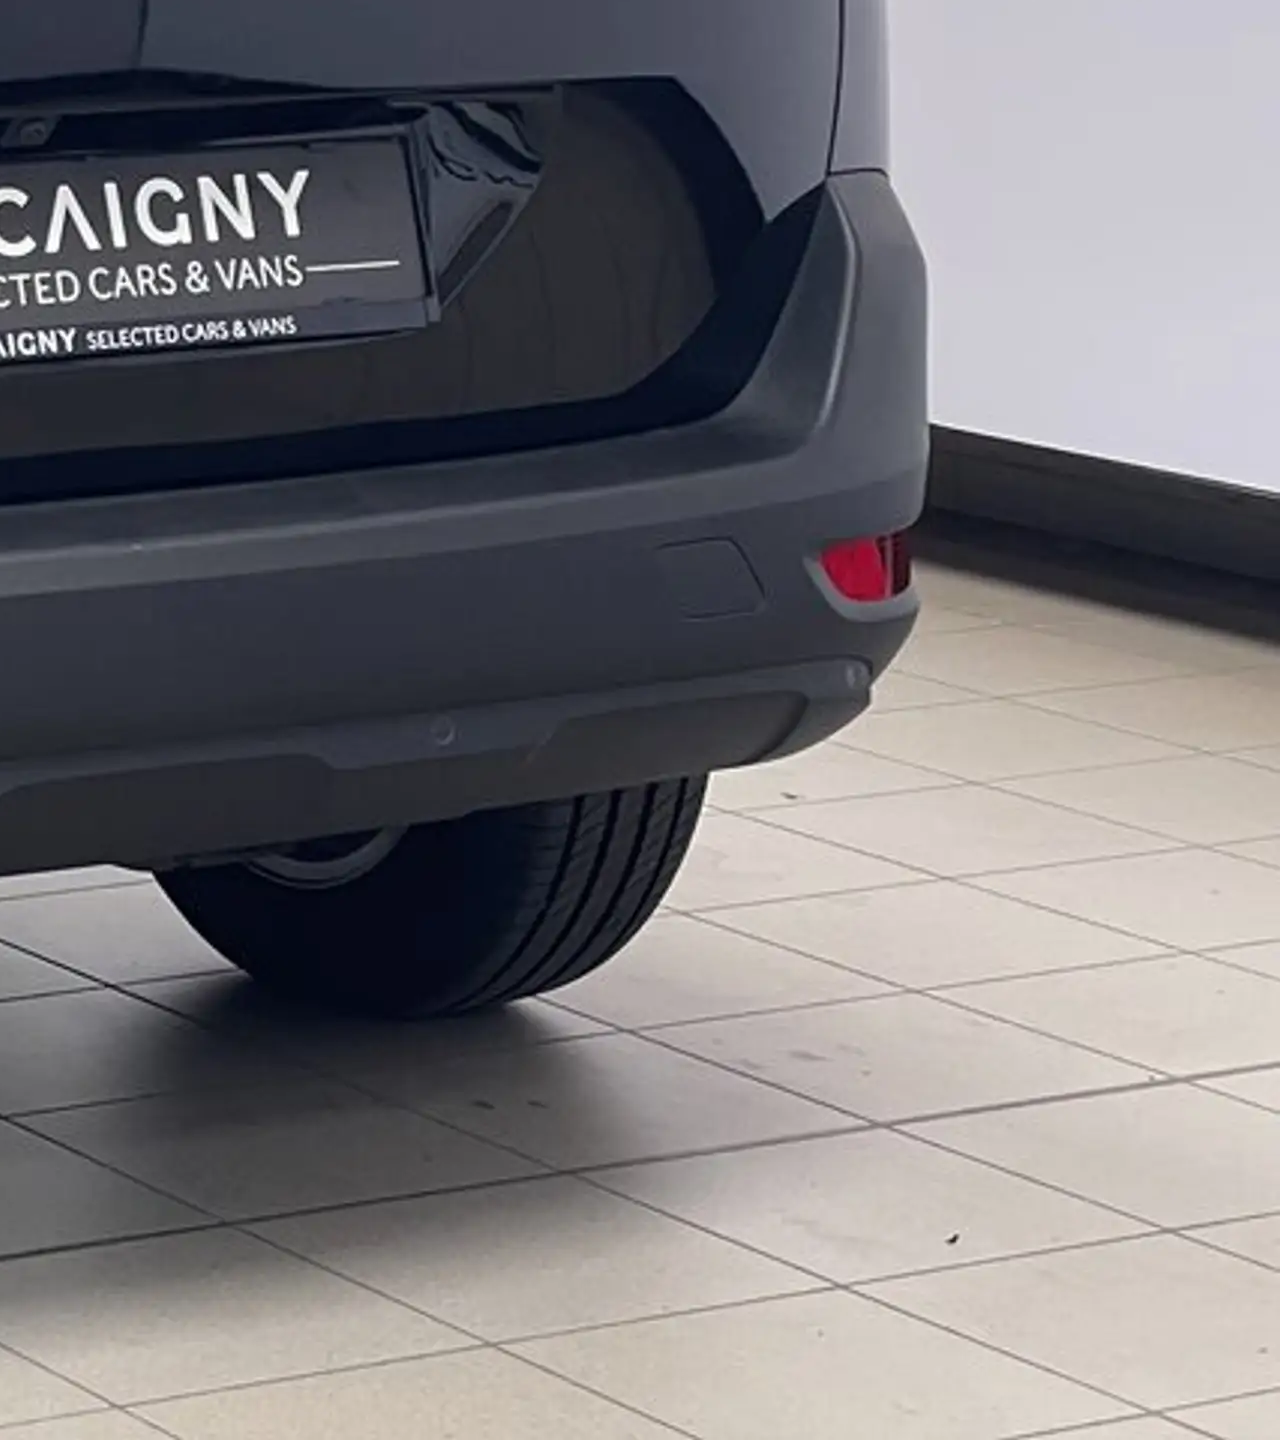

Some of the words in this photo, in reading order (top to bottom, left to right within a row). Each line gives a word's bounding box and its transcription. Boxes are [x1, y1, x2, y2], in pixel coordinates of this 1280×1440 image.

[87, 262, 178, 301] CARS
[184, 260, 211, 295] &
[213, 254, 304, 291] VANS
[85, 324, 180, 351] SELECTED
[181, 320, 229, 344] CARS
[232, 319, 247, 339] &
[248, 315, 298, 338] VANS
